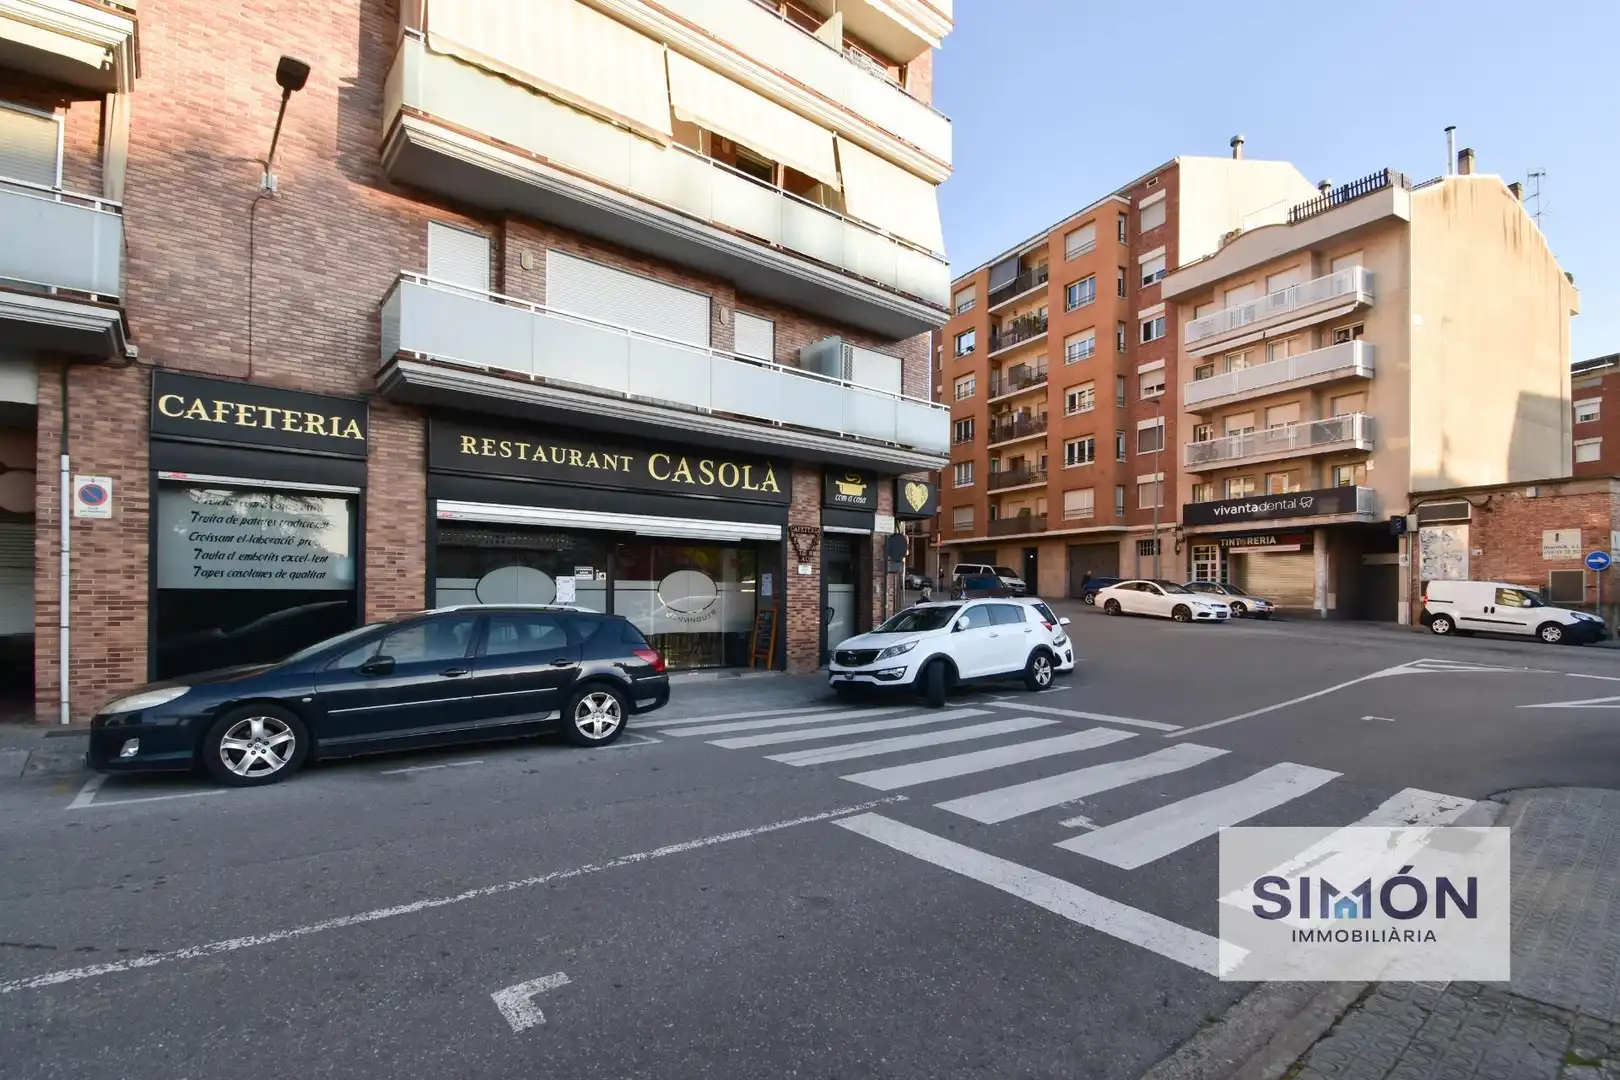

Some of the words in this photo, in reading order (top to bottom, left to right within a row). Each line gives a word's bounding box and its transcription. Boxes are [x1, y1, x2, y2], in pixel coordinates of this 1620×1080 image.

[157, 393, 365, 440] CAFETERIA
[459, 434, 634, 473] RESTAURANT
[648, 452, 781, 493] CASOLÀ
[1213, 498, 1297, 516] vivantadental
[225, 514, 239, 525] de
[189, 531, 235, 543] Croissant
[194, 548, 225, 560] Taula
[193, 565, 224, 579] Tapes
[226, 568, 272, 578] casolanes
[274, 569, 288, 579] de
[289, 569, 327, 580] qualitat
